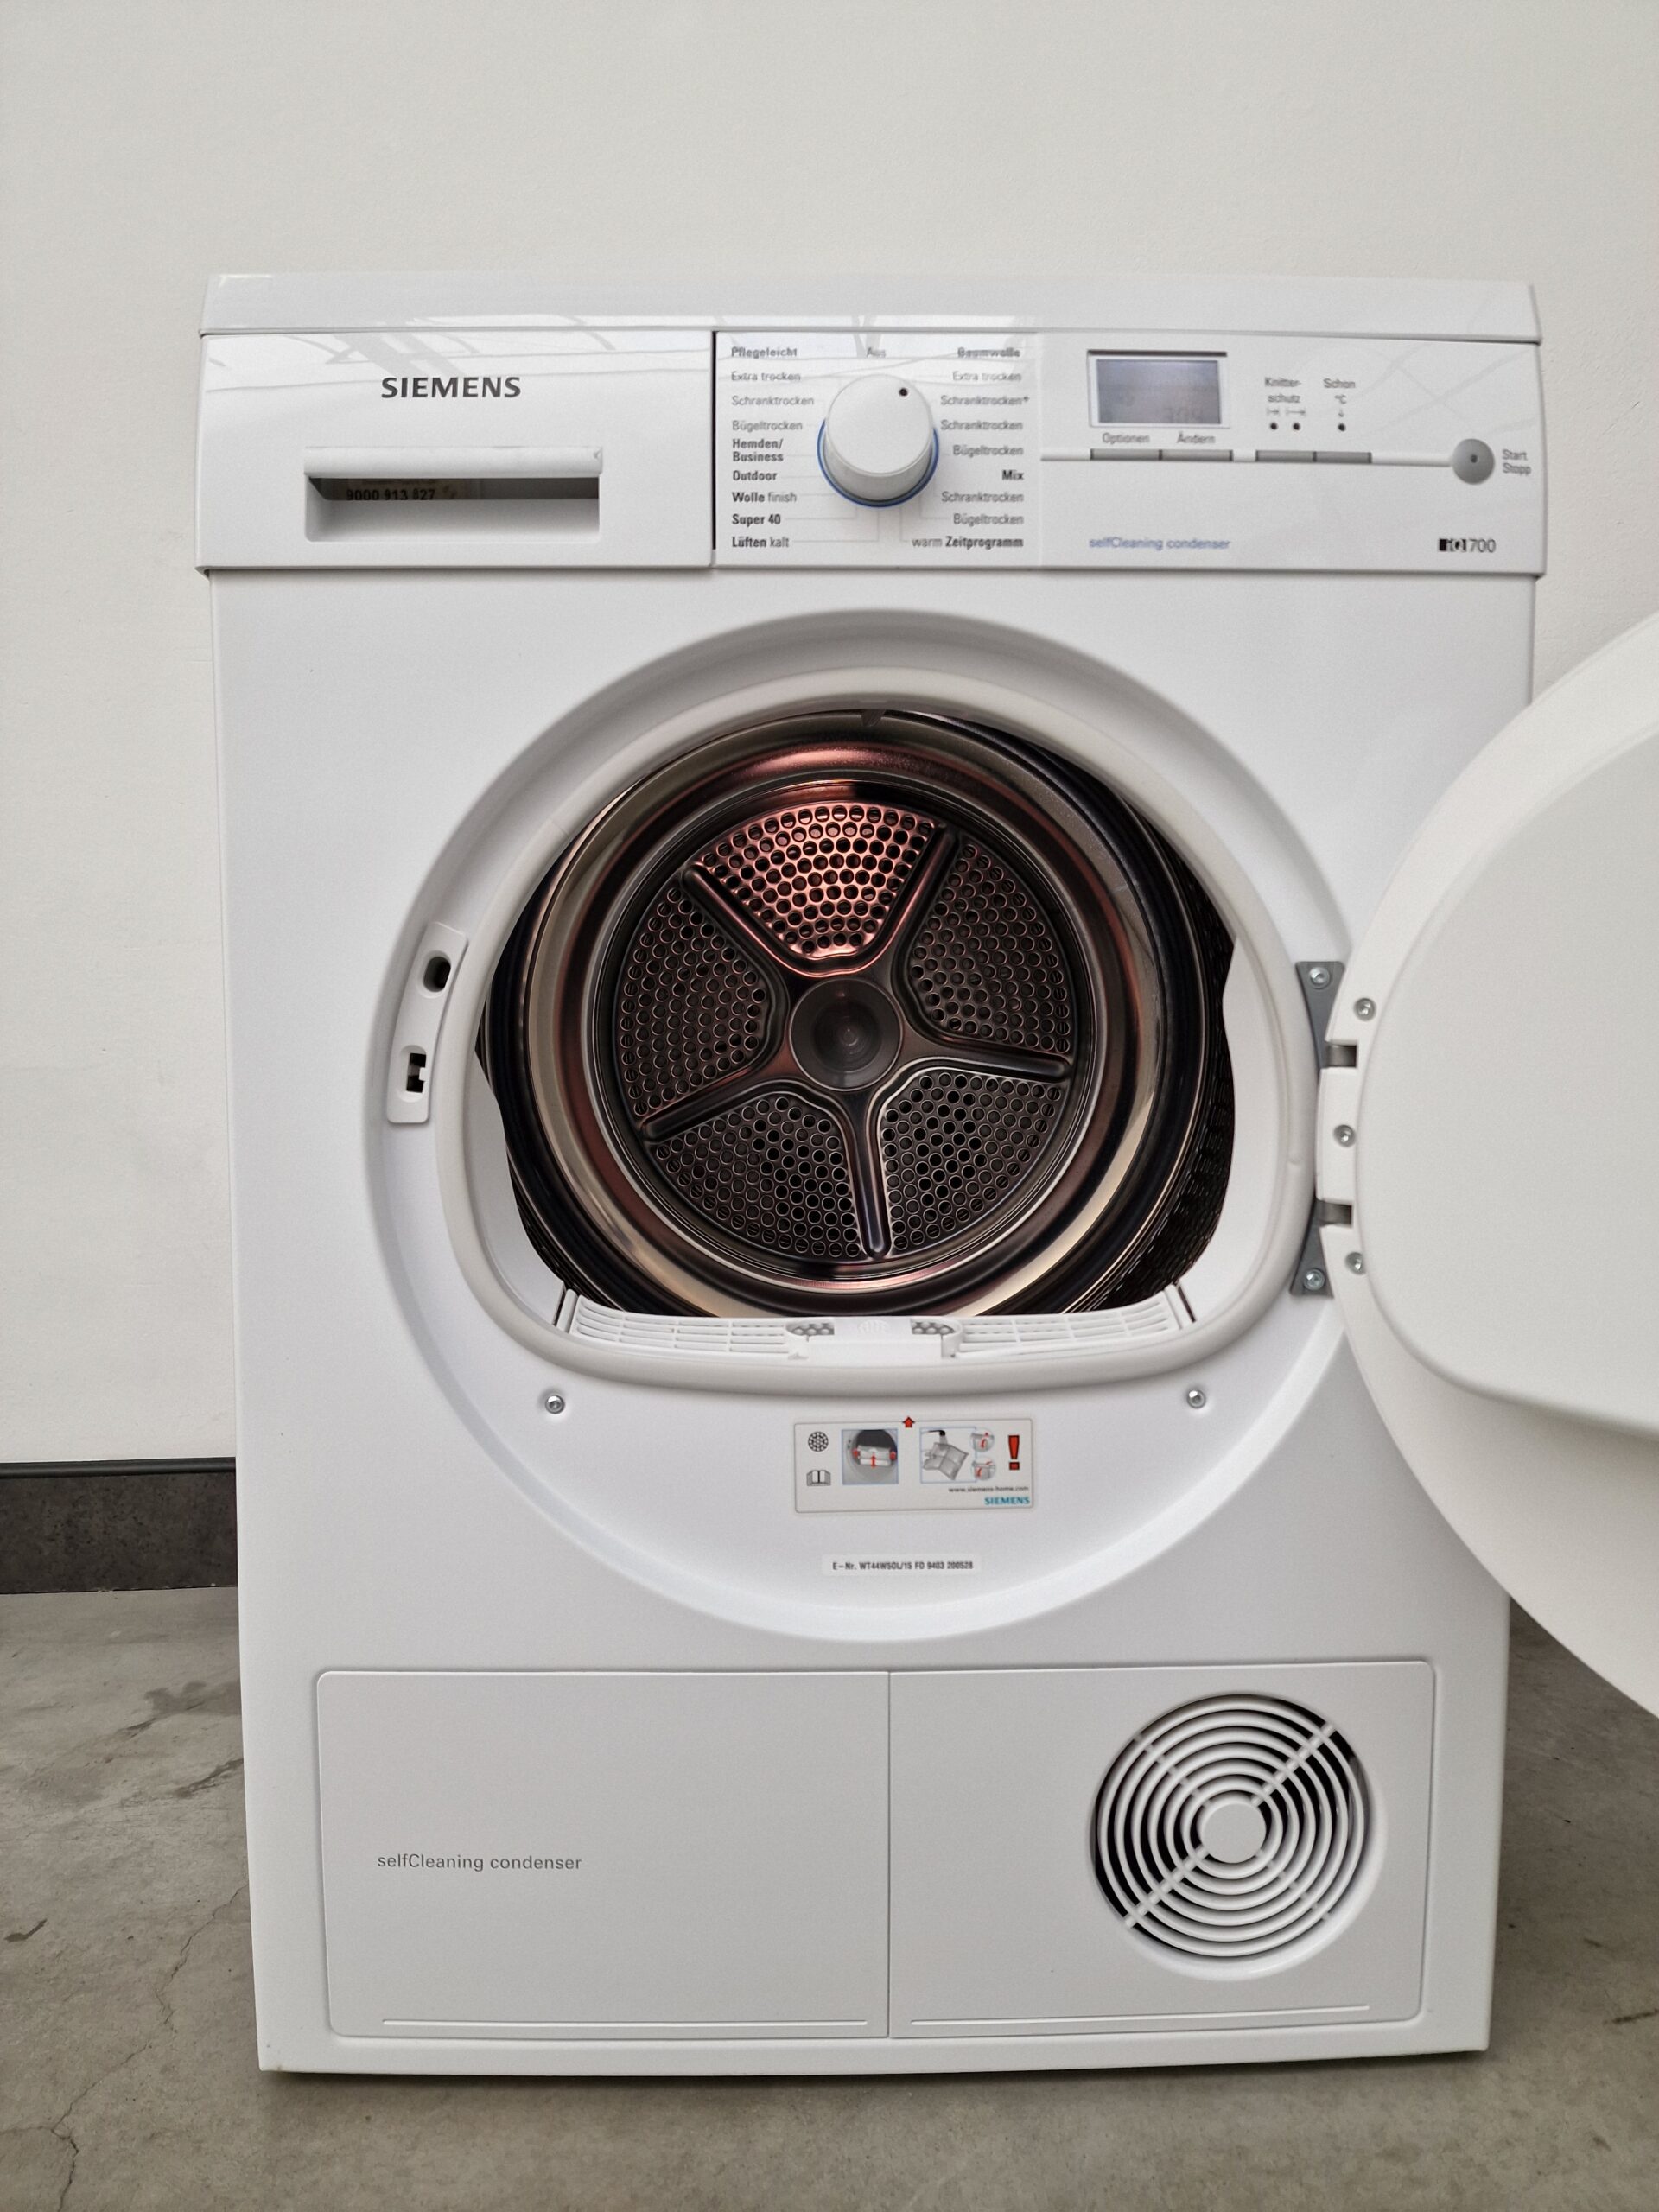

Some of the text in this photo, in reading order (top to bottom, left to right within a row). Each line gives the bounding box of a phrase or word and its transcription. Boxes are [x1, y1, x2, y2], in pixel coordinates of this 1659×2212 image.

[731, 346, 798, 359] Pflegeleicht
[731, 371, 801, 381] Extra trocken
[952, 371, 1021, 381] Extra trocken
[381, 377, 521, 398] SIEMENS
[1323, 378, 1356, 389] Schon
[731, 395, 814, 406] Schranktrocken
[732, 420, 803, 433] Bügeltrocken
[940, 419, 1023, 431] Schranktrocken
[732, 438, 784, 450] Hemden/
[1102, 432, 1151, 445] Optionen
[1177, 431, 1216, 444] Ändern
[732, 451, 784, 462] Business
[952, 444, 1024, 459] Bügeltrocken
[1503, 448, 1529, 461] Start
[732, 469, 778, 481] Outdoor
[1001, 469, 1024, 480] Mix
[1503, 462, 1532, 476] Stopp
[346, 489, 379, 500] 9000
[384, 489, 409, 500] 913
[731, 492, 798, 503] Wolle finish
[941, 490, 1024, 503] Schranktrocken
[731, 513, 781, 528] Super 40
[953, 512, 1024, 528] Bügeltrocken
[731, 536, 790, 548] Lüften kalt
[911, 535, 1024, 550] warm Zeitprogramm
[1089, 537, 1230, 551] selfCleaning condenser
[984, 1496, 1030, 1505] SIEMENS
[378, 1853, 582, 1872] selfCleaning condenser
